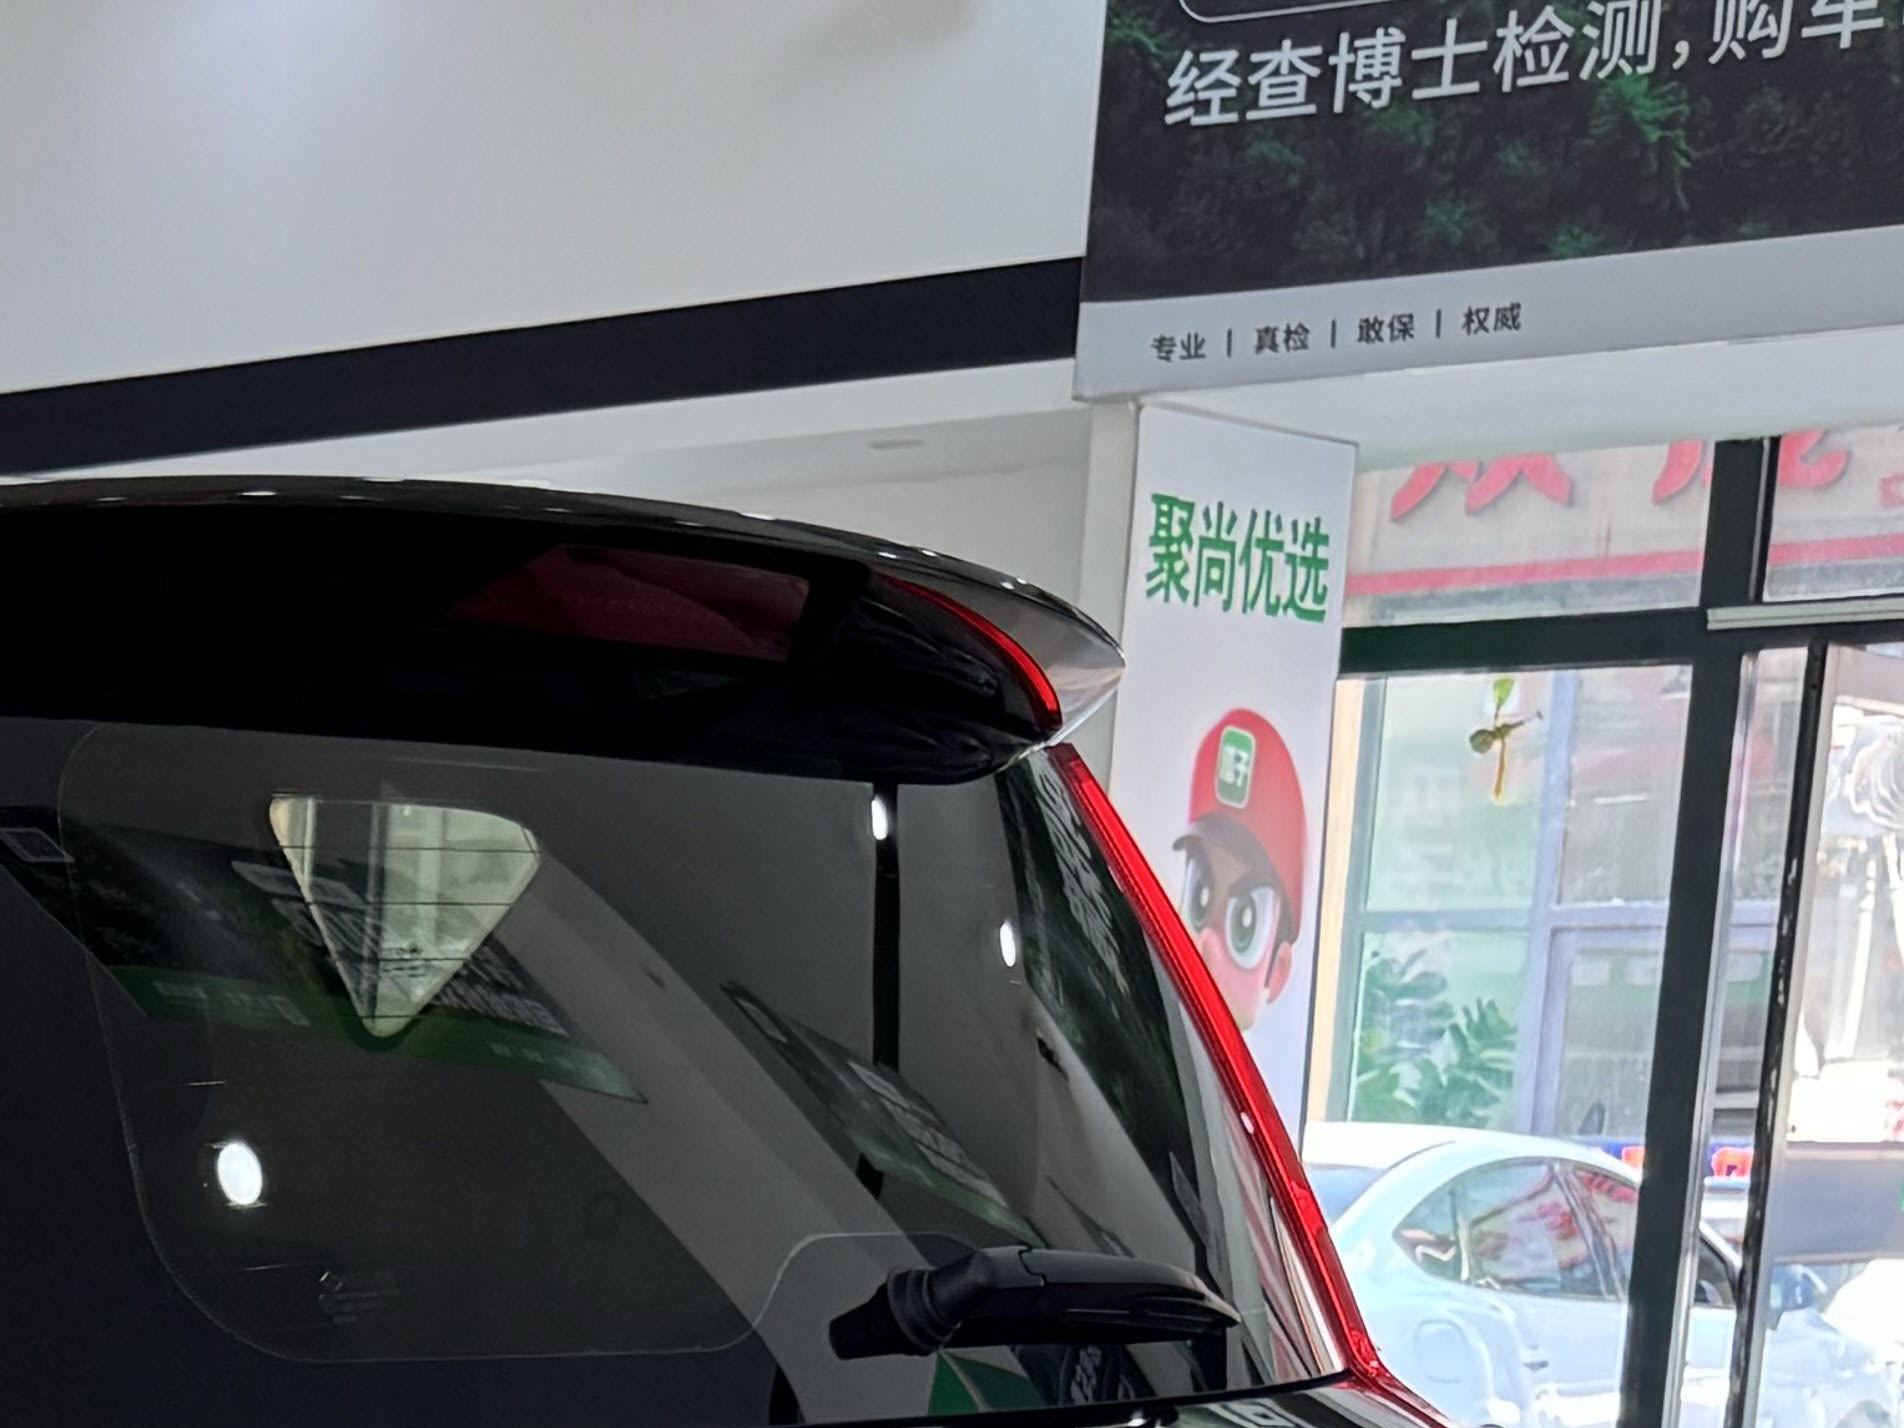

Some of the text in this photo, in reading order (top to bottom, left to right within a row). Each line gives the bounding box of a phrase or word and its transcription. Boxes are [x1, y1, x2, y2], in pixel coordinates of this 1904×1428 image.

[1149, 301, 1523, 362] 专业 真检 敢保 权威
[1145, 493, 1330, 624] 聚尚优选
